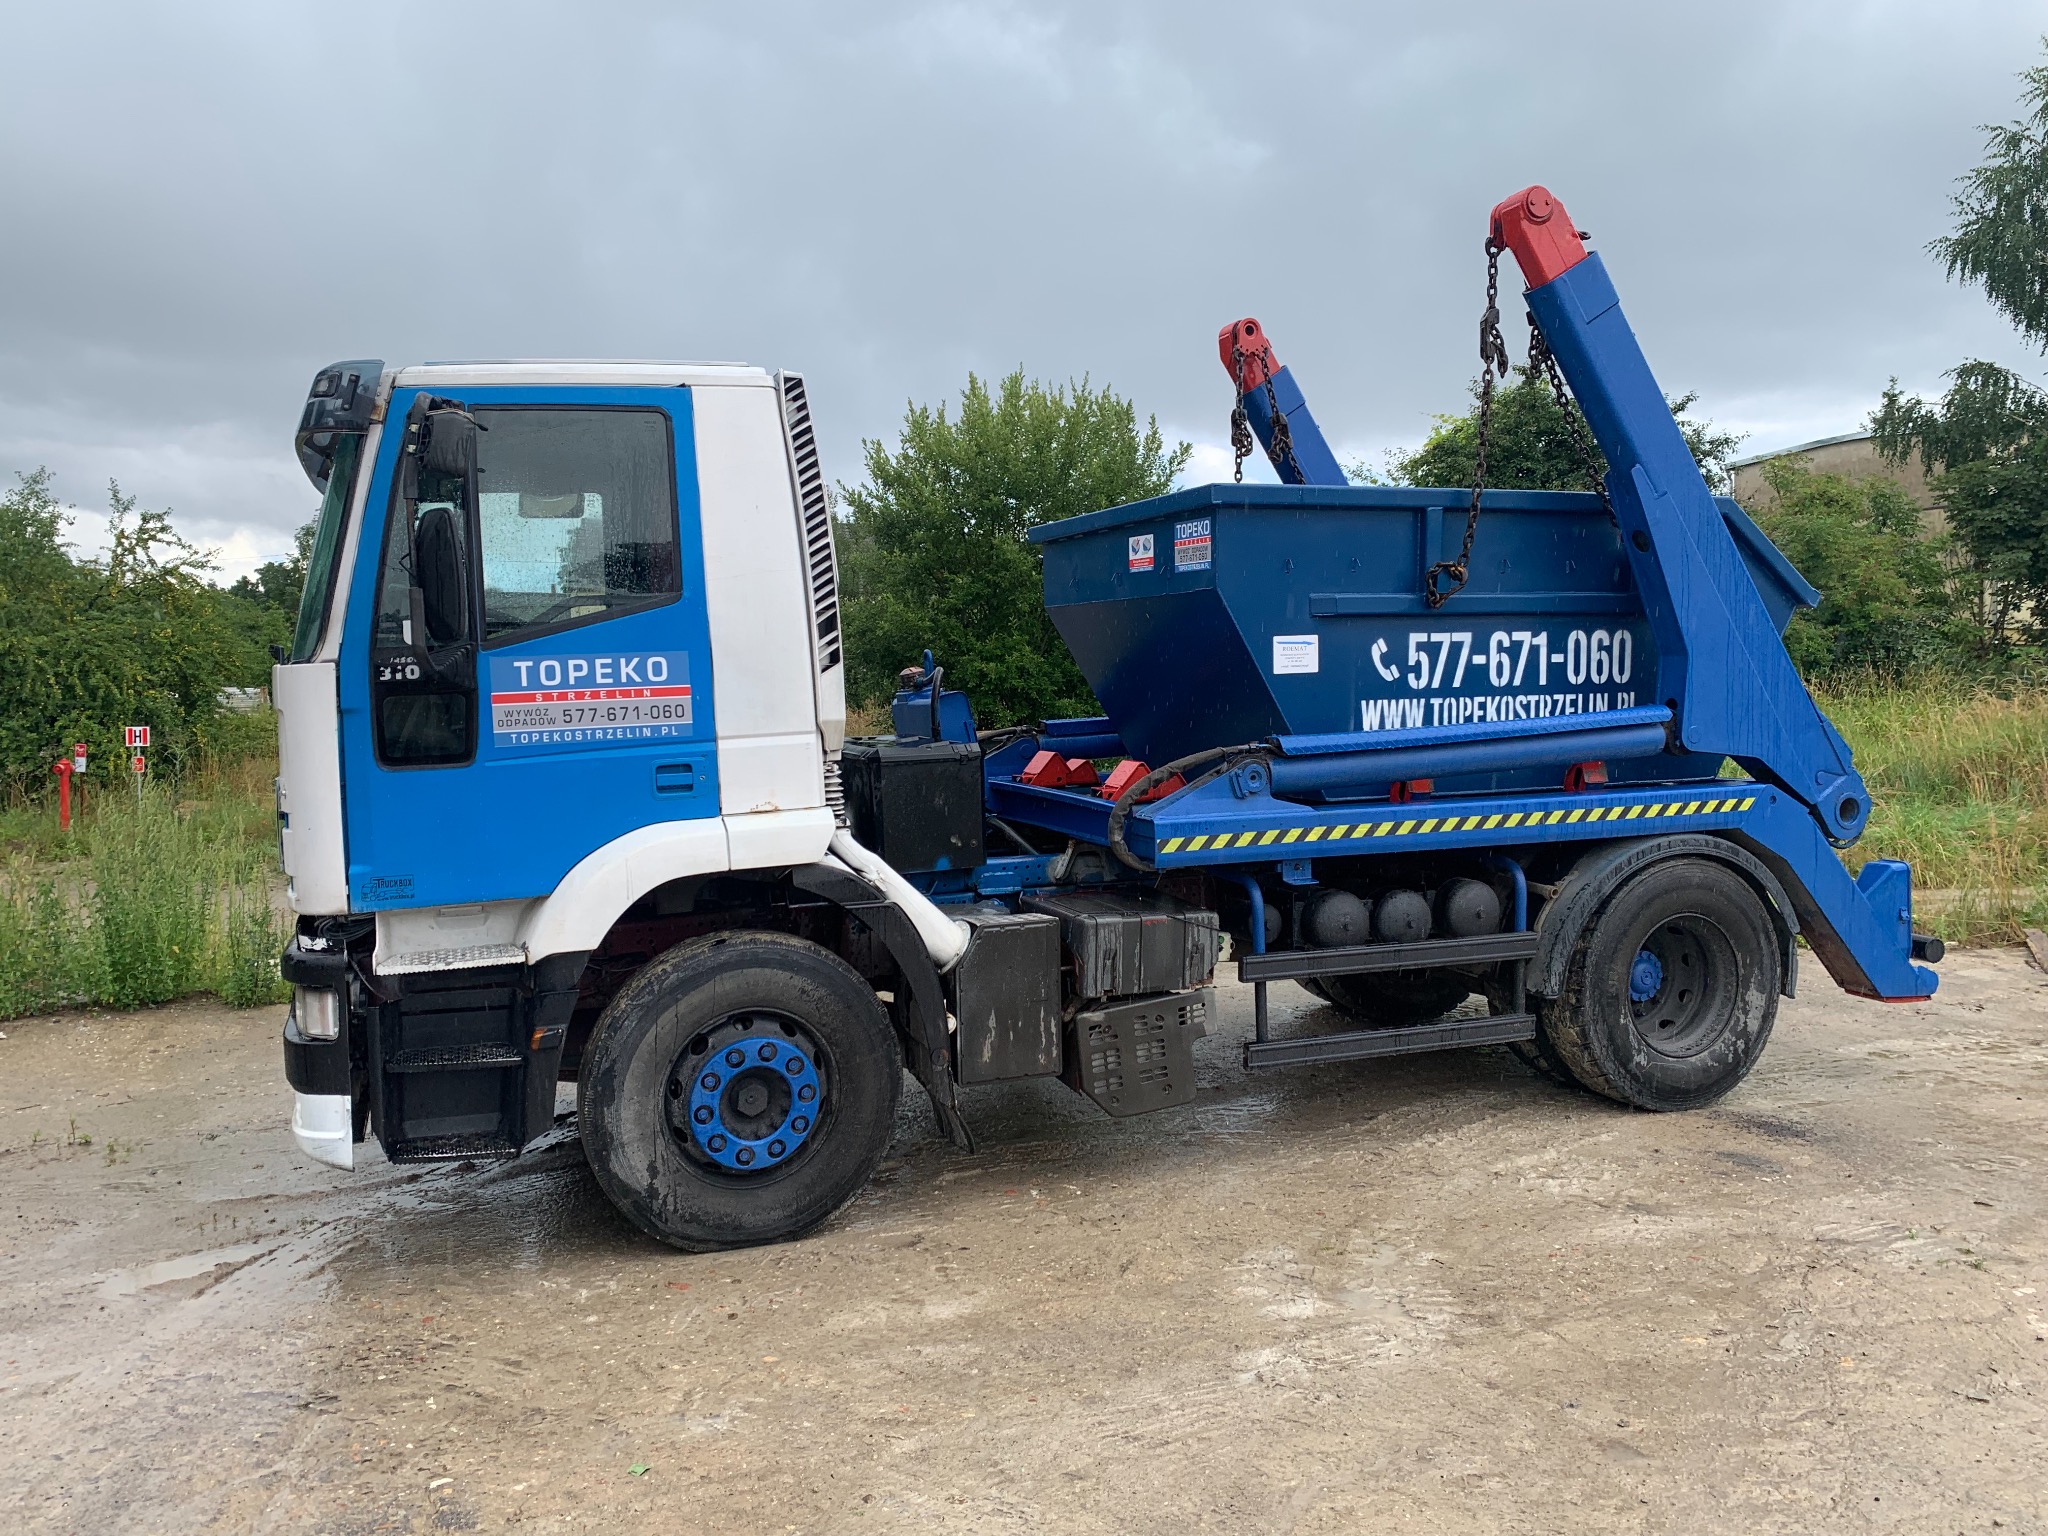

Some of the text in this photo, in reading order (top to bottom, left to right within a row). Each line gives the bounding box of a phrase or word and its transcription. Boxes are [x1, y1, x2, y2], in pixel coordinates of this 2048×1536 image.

[1176, 520, 1210, 539] TOPEKO
[1407, 629, 1633, 690] 577-671-060
[513, 656, 668, 687] TOPEKO
[535, 689, 651, 702] STRZELIN
[497, 716, 557, 728] ODPADÓW
[503, 703, 686, 724] WYWÓZ 577-671-060
[134, 730, 142, 743] H
[510, 726, 679, 745] TOPEKOSTRZELIN.PL
